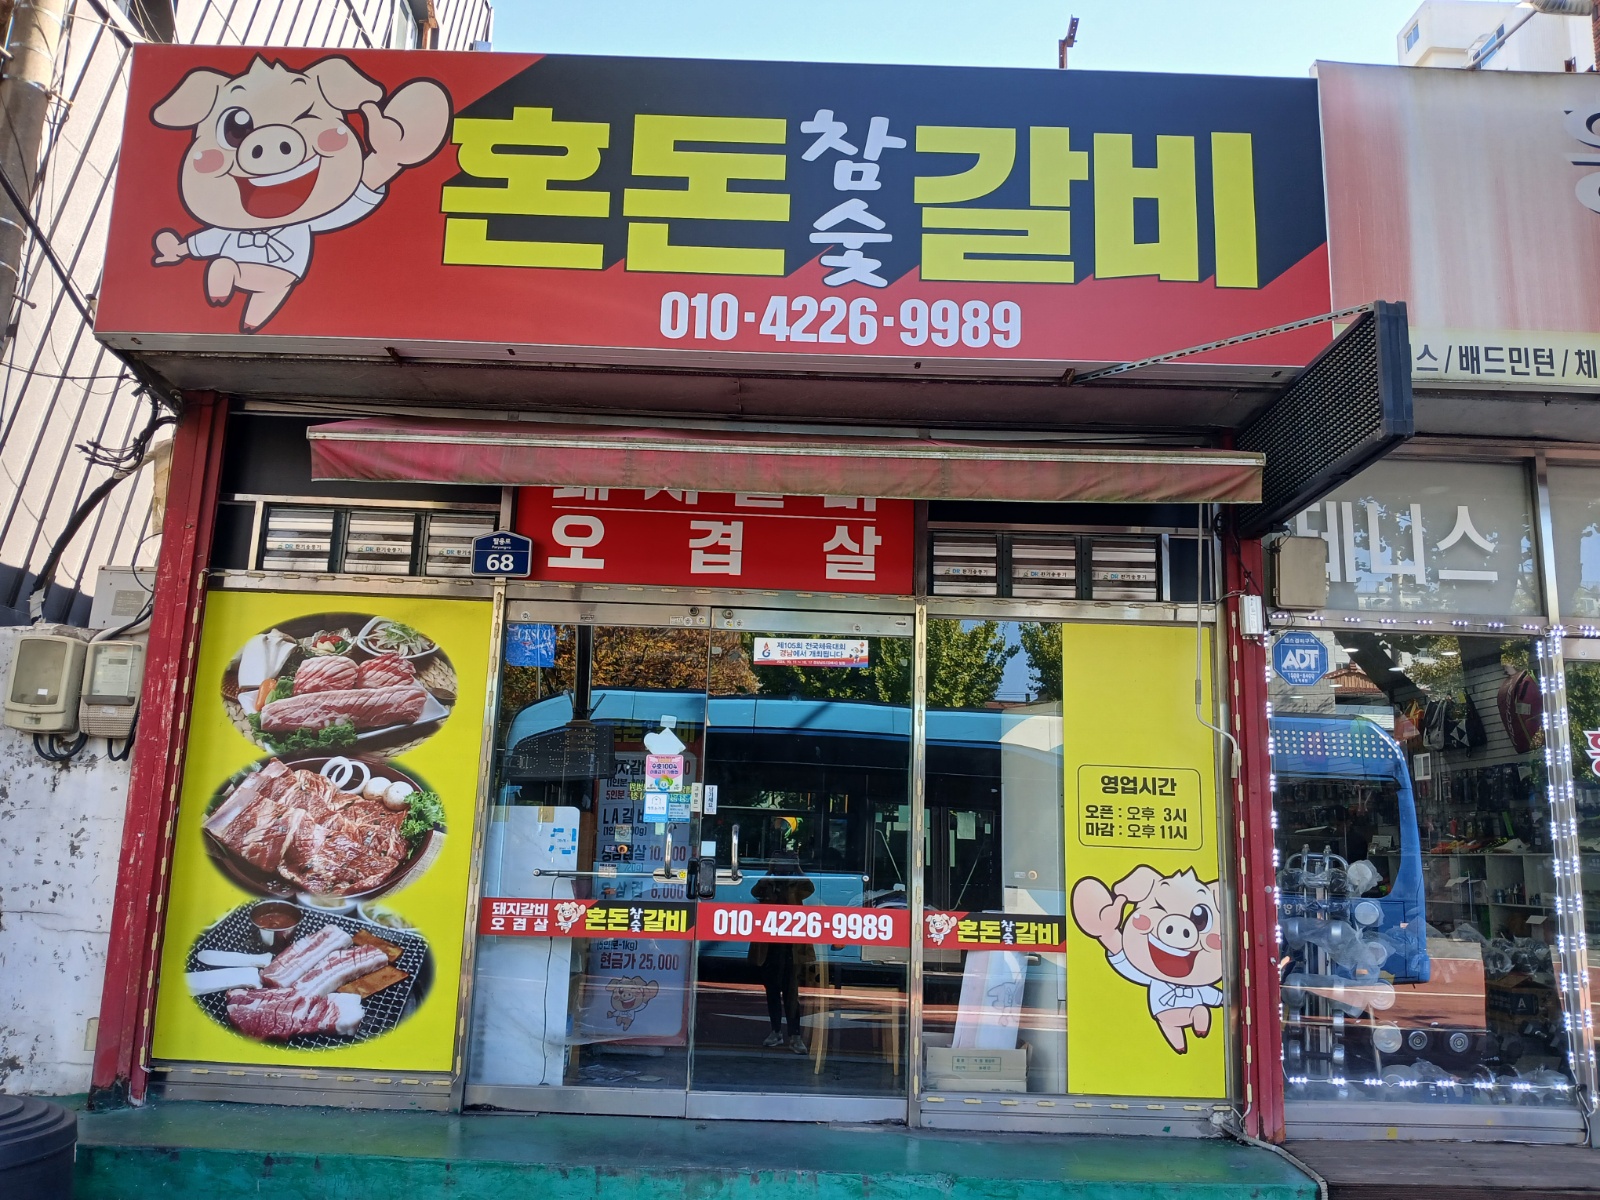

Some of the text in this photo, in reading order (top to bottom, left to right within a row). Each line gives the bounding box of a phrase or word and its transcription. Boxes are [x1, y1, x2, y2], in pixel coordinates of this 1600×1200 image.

[441, 106, 791, 277] 혼돈
[914, 125, 1260, 289] 갈비
[486, 554, 514, 571] 68
[805, 642, 846, 650] 전국체육대회
[808, 650, 844, 658] 개최됩니다
[1281, 649, 1319, 670] ADT
[1100, 775, 1177, 796] 영업시간
[1085, 804, 1114, 820] 오픈
[1127, 806, 1155, 821] 오후
[1163, 807, 1187, 822] 3시
[1085, 822, 1115, 837] 마감
[1127, 823, 1156, 838] 오후
[1159, 825, 1188, 840] 11시
[649, 845, 686, 862] 10,00
[491, 902, 549, 917] 돼지갈비
[585, 908, 629, 931] 혼돈
[643, 909, 687, 933] 갈비
[957, 920, 1001, 944] 혼돈
[1015, 921, 1060, 946] 갈비
[600, 952, 680, 971] 현금가 25,000
